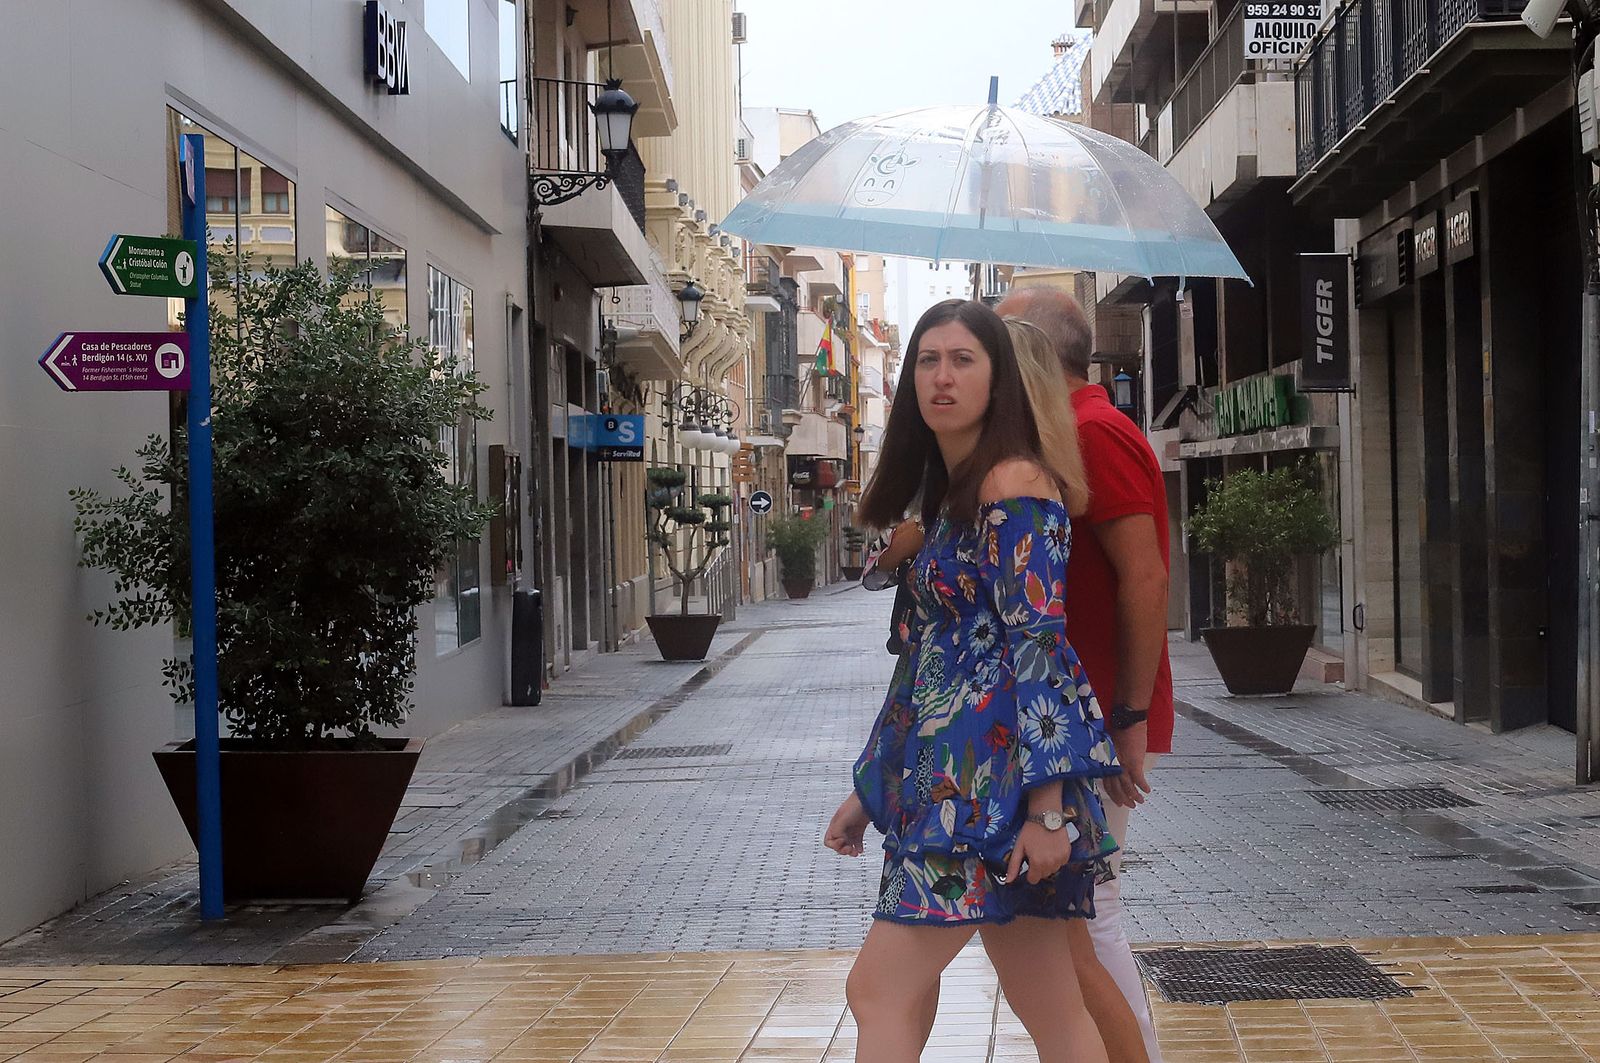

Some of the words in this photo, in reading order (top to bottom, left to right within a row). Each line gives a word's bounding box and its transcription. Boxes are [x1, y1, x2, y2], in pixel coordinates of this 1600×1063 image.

[1247, 4, 1270, 15] 959
[1272, 4, 1287, 15] 24
[1290, 5, 1305, 16] 90
[1307, 5, 1321, 16] 37
[1254, 22, 1316, 40] ALQUILO
[378, 0, 410, 94] BBVA
[1446, 210, 1470, 249] TIGER
[129, 246, 160, 256] Monumento
[1415, 226, 1436, 263] TIGER
[129, 258, 152, 268] Cristóbal
[153, 259, 168, 268] Colón
[1316, 278, 1333, 364] TIGER
[100, 342, 110, 350] de
[111, 342, 152, 350] Pescadores
[82, 353, 115, 363] Berdigón
[126, 354, 135, 362] (s.
[136, 354, 148, 362] XV)
[90, 374, 112, 382] Berdigón
[618, 421, 635, 443] S
